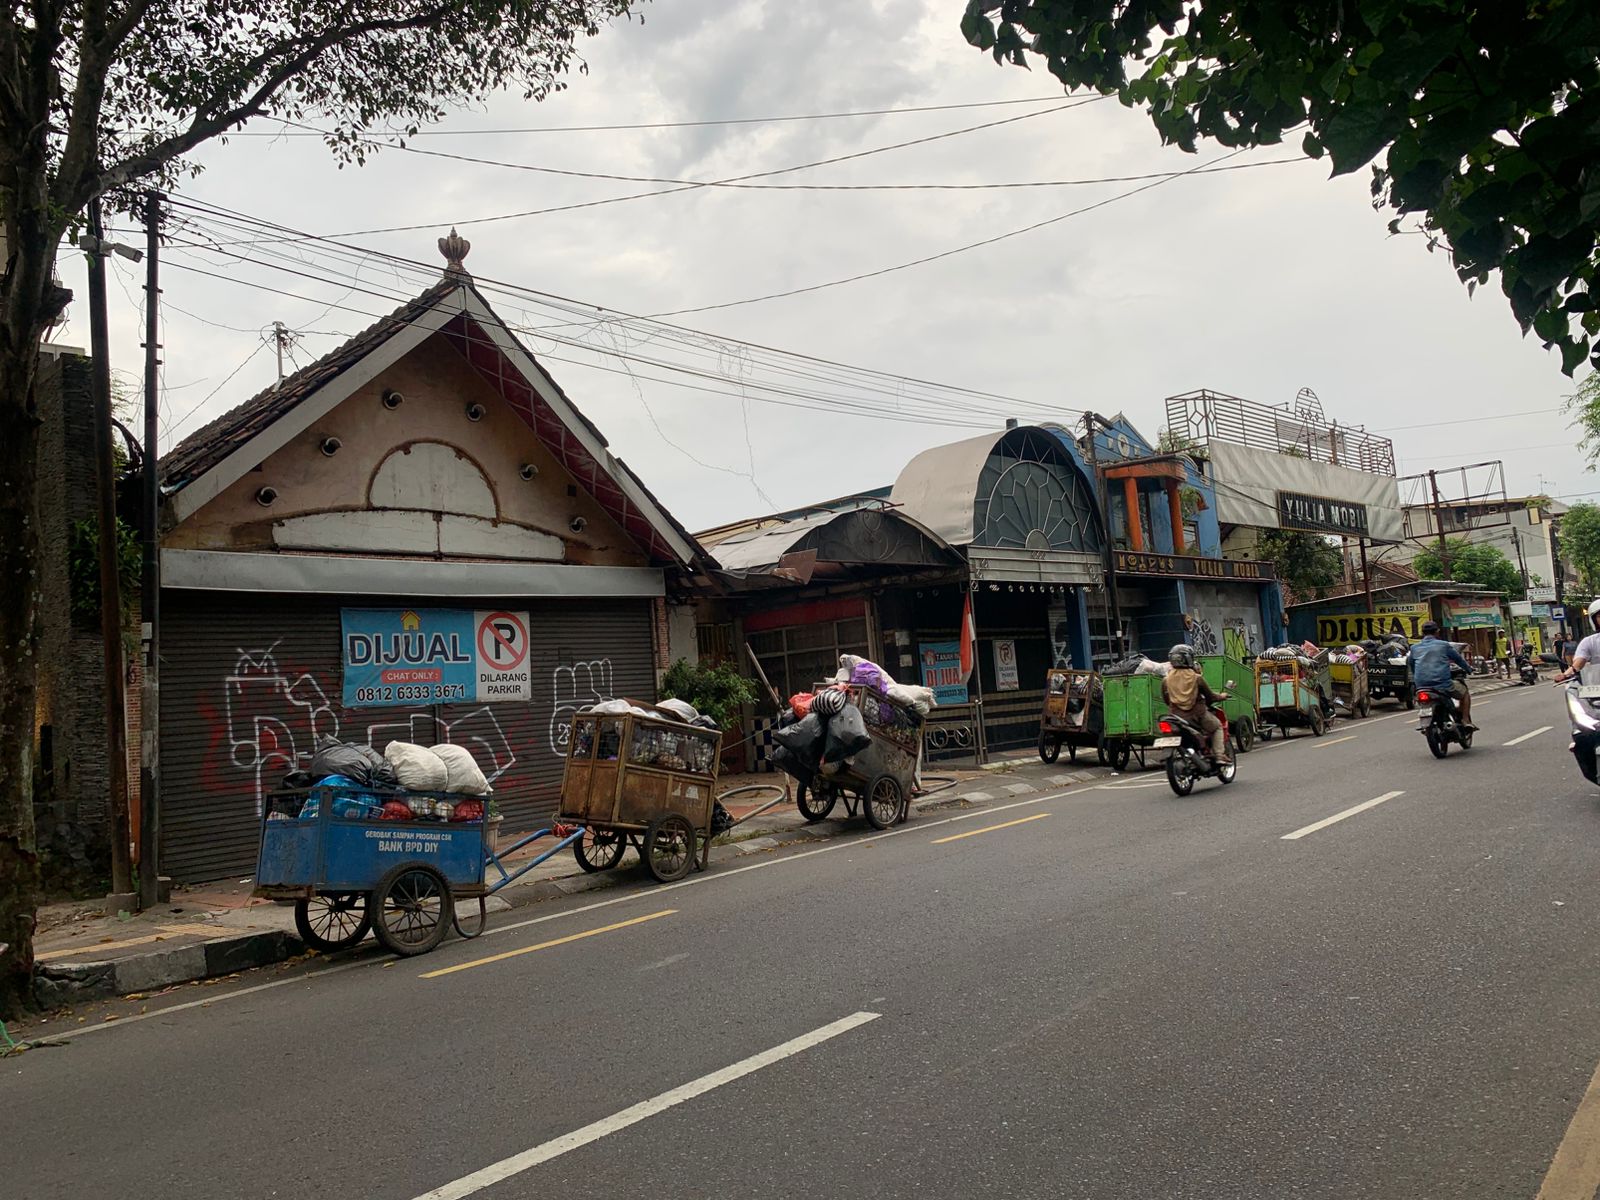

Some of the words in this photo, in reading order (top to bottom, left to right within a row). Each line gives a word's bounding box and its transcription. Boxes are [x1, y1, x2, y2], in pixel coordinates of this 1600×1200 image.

[1285, 499, 1325, 524] YULIA
[1330, 505, 1368, 529] MOBIL
[1194, 559, 1224, 576] YULIA
[1319, 616, 1425, 643] DIJUAL
[347, 633, 471, 666] DIJUAL
[386, 672, 409, 681] CHAT
[411, 672, 433, 681] ONLY
[480, 672, 528, 683] DILARANG
[357, 687, 392, 701] 0812
[398, 686, 430, 700] 6333
[435, 685, 465, 698] 3671
[487, 684, 522, 694] PARKIR
[365, 830, 392, 839] GEROBAK
[392, 831, 415, 840] SAMPAH
[415, 832, 441, 841] PROGRAM
[441, 833, 452, 841] CSR
[378, 840, 403, 852] BANK
[405, 841, 423, 853] BPD
[424, 842, 439, 853] DIY
